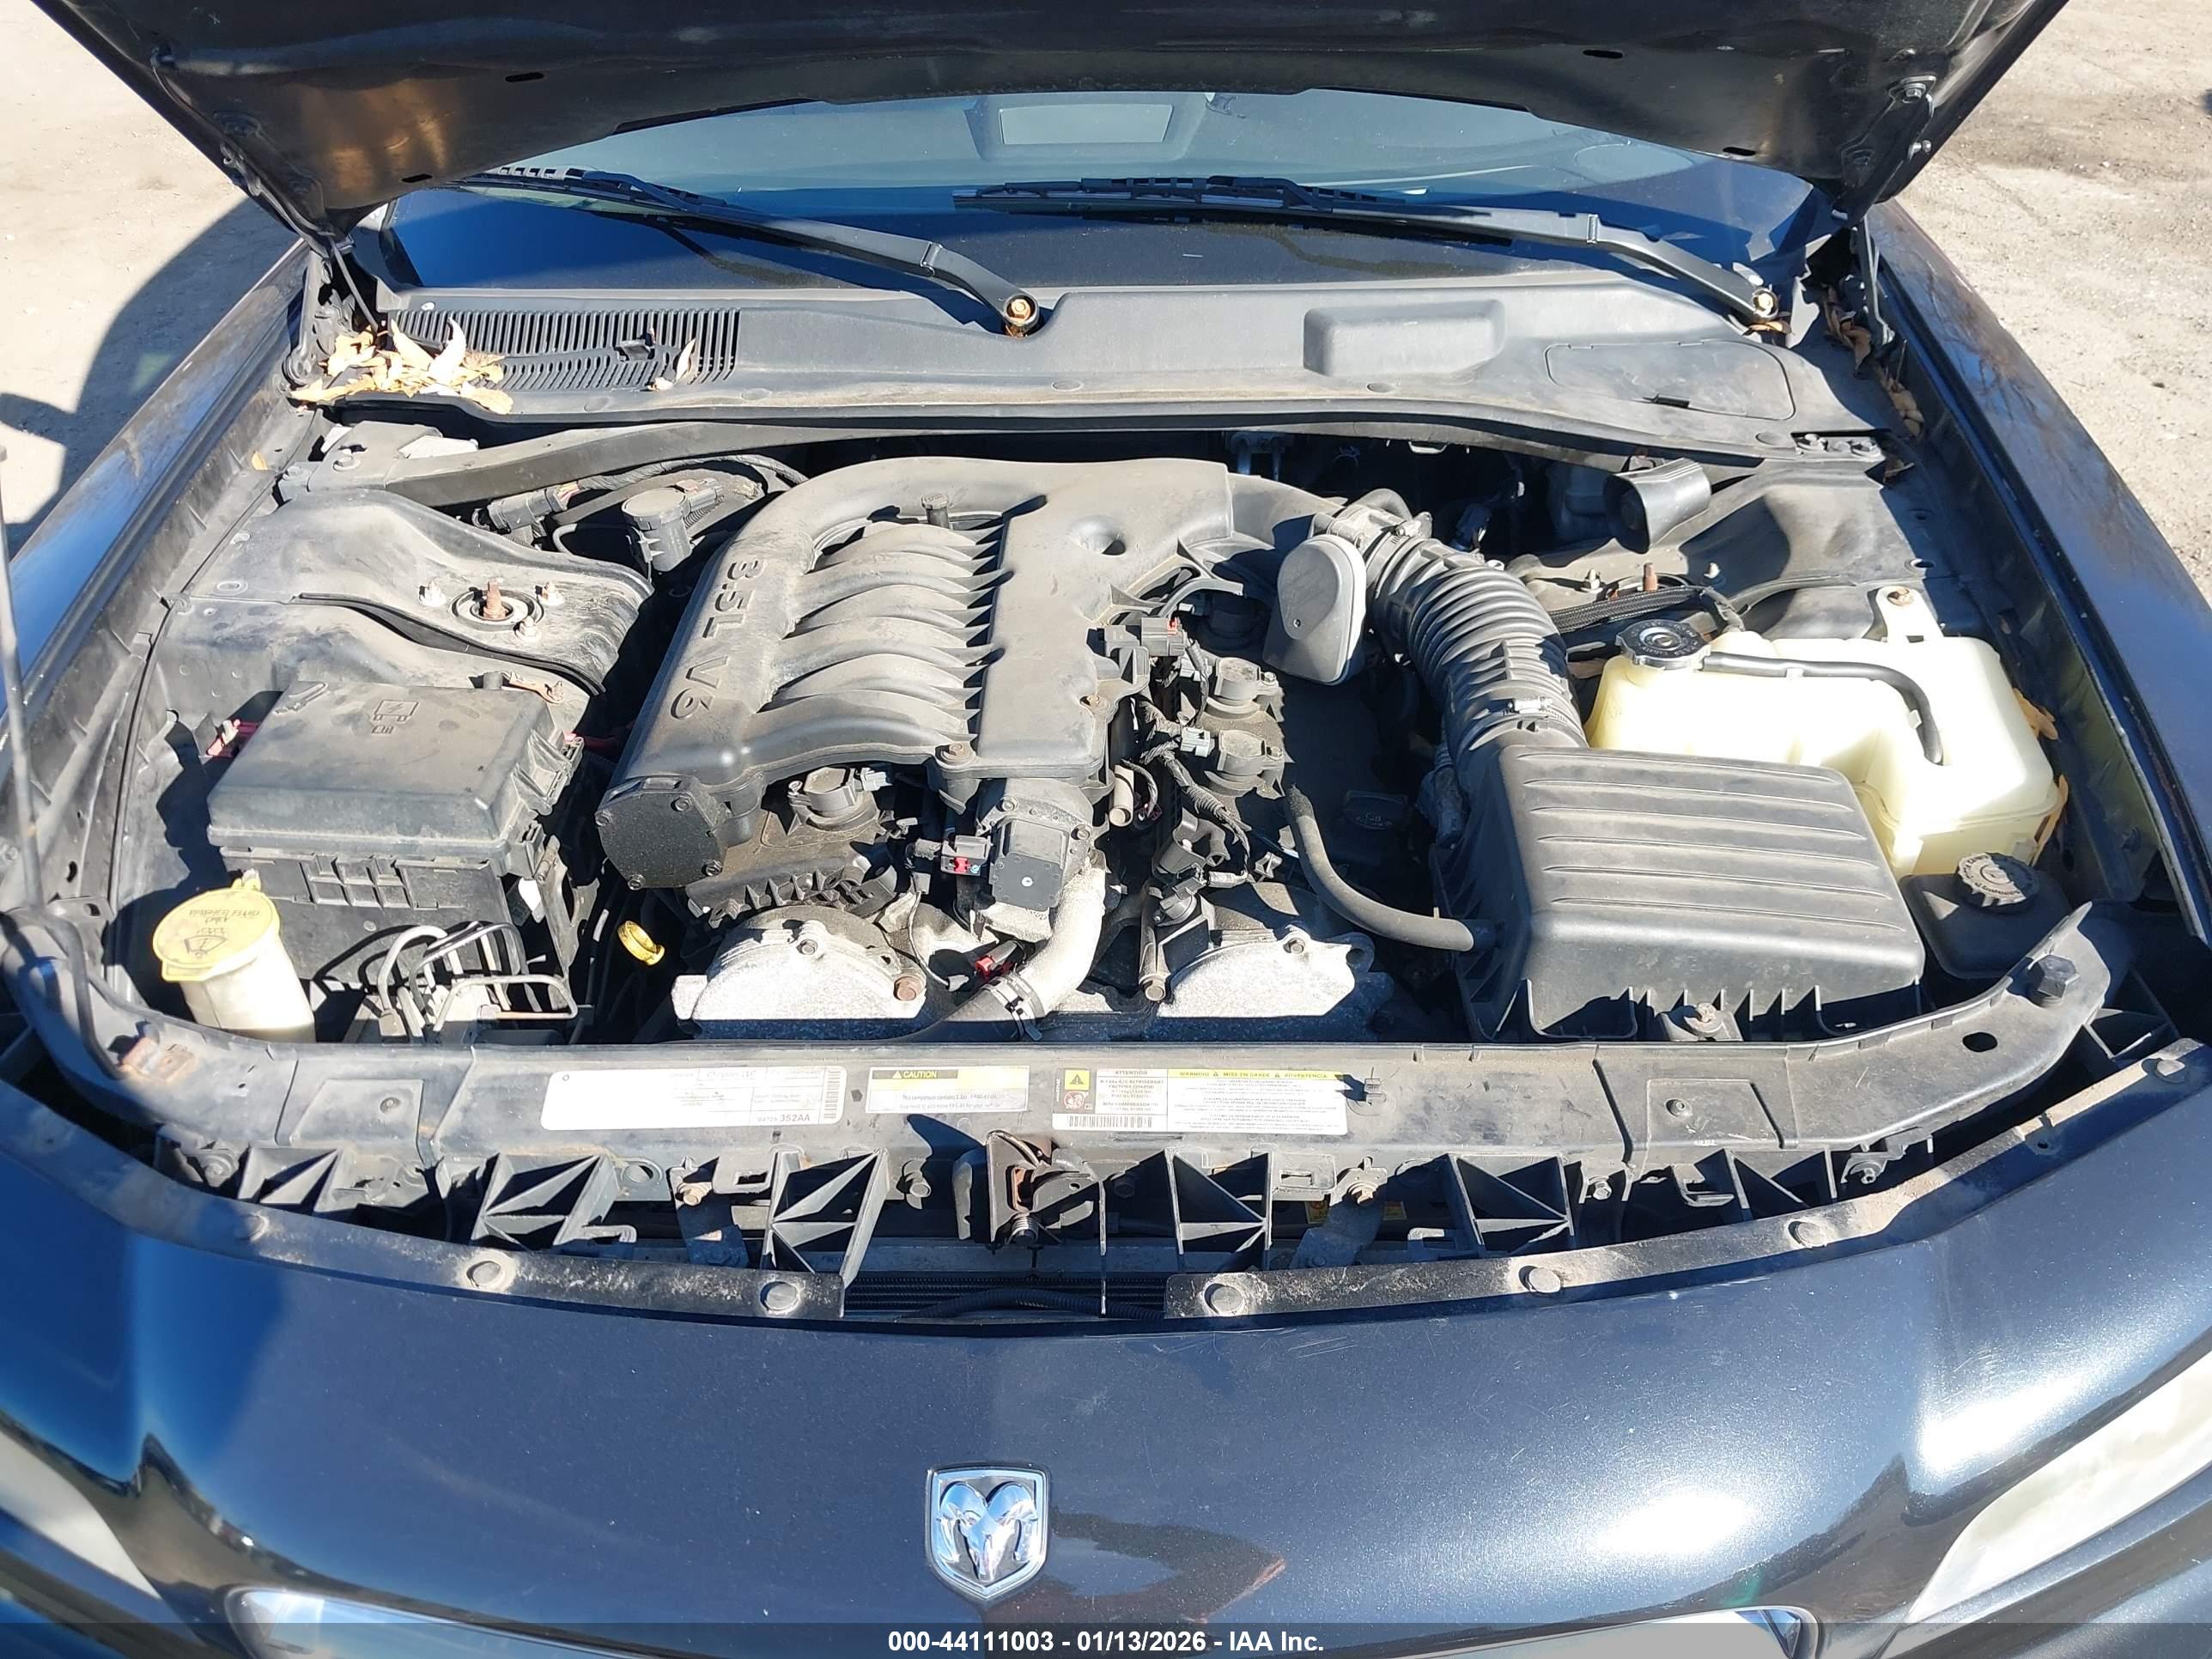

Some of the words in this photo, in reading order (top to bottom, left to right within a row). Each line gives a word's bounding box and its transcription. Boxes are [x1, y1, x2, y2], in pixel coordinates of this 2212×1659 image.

[702, 560, 767, 639] 3.5L
[671, 655, 730, 720] V6
[780, 1114, 811, 1122] 352AA
